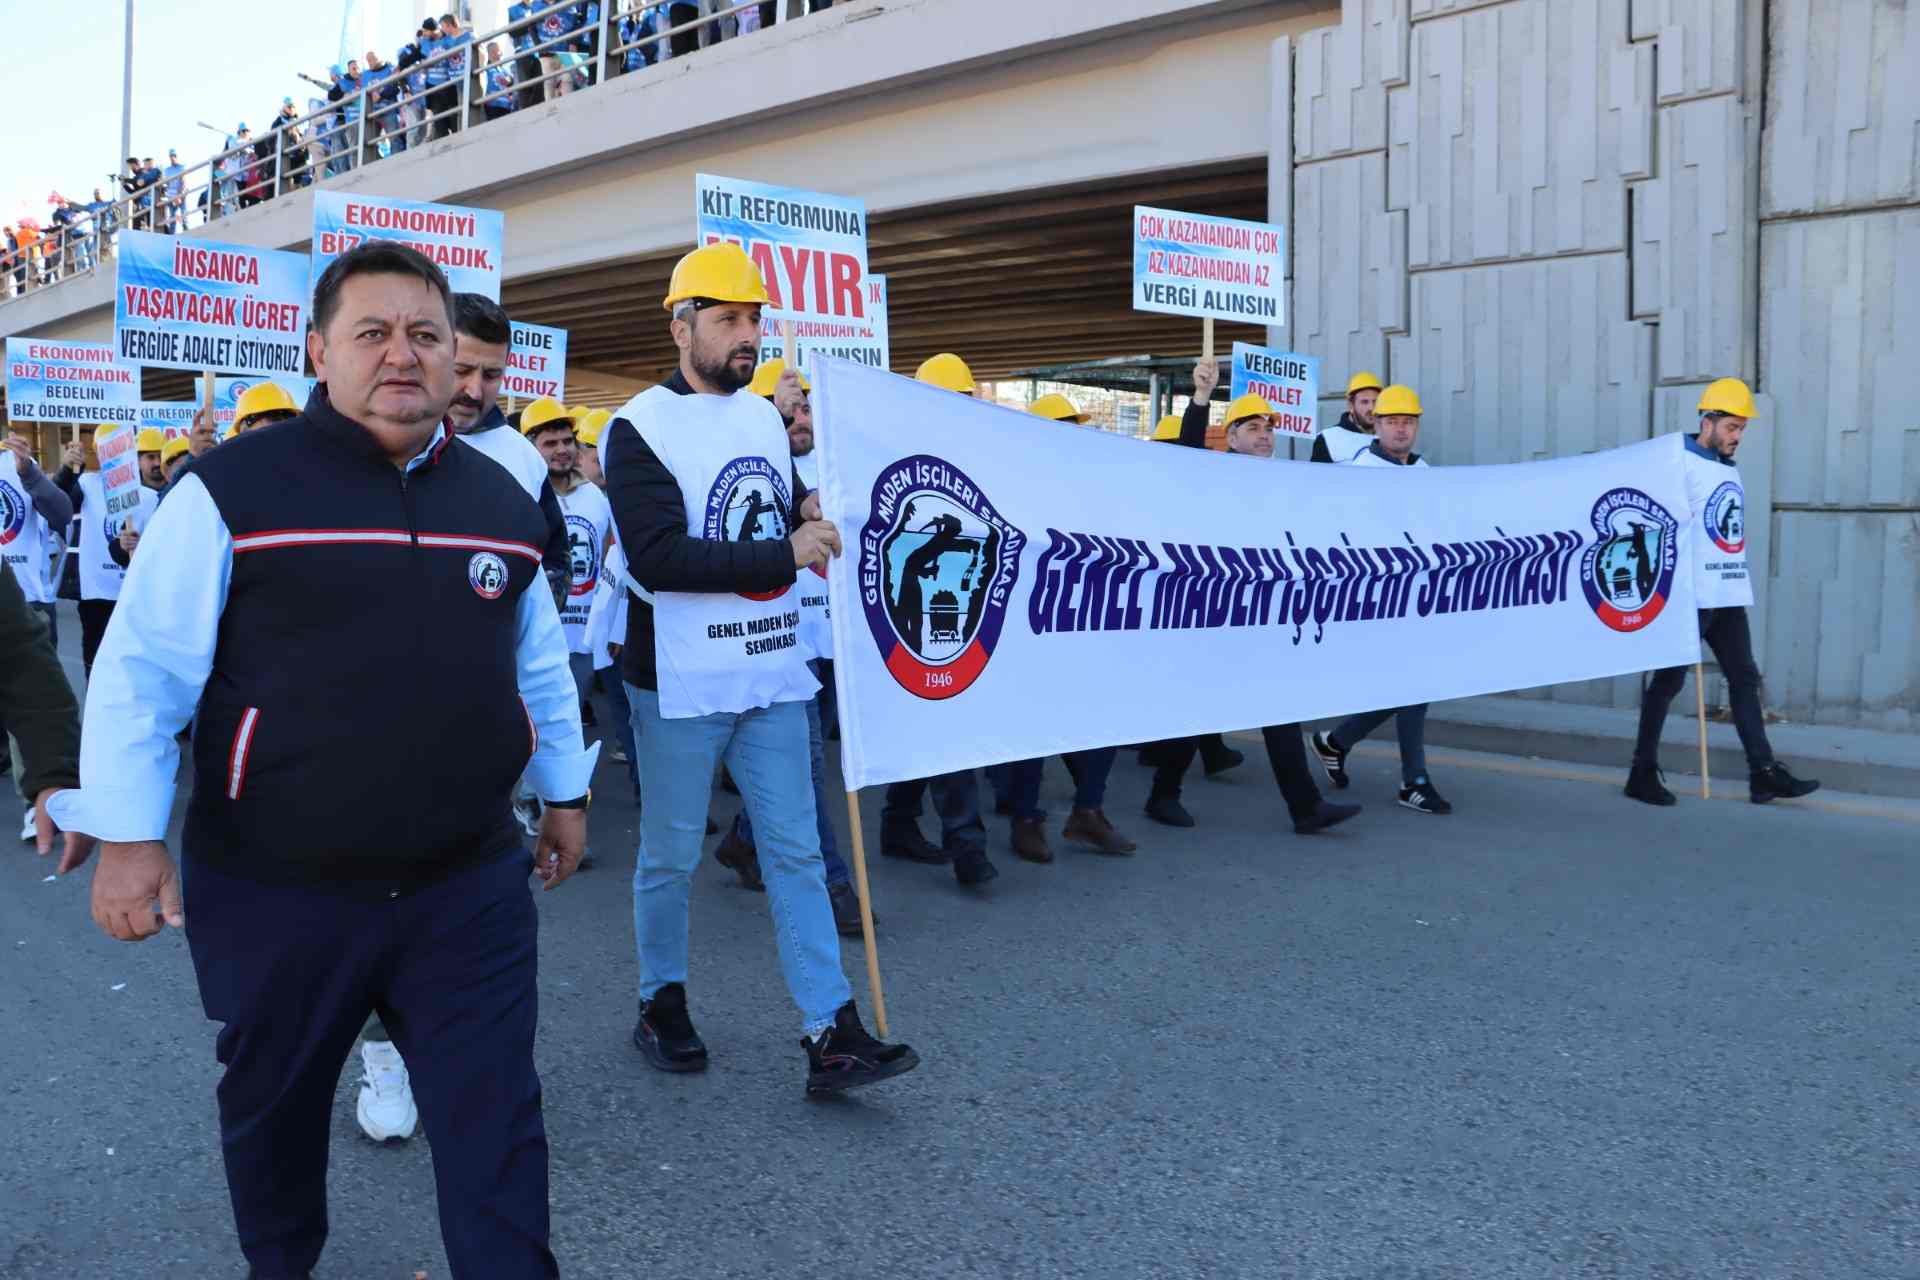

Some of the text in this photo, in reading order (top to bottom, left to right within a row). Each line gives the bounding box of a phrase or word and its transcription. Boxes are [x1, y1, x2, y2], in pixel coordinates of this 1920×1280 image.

[346, 204, 475, 238] EKONOMİYİ
[702, 186, 862, 236] KİT REFORMUNA
[1140, 214, 1279, 254] ÇOK KAZANANDAN ÇOK
[175, 242, 259, 286] İNSANCA
[385, 239, 494, 271] MADIK,
[1148, 252, 1269, 287] AZ KAZANANDAN AZ
[706, 235, 864, 319] AYIR
[126, 286, 300, 333] YAŞAYACAK ÜCRET
[1143, 282, 1277, 317] VERGİ ALINSIN
[121, 326, 300, 372] VERGİDE ADALET İSTİYORUZ
[513, 328, 553, 350] GİDE
[505, 352, 548, 372] ALET
[1245, 352, 1308, 381] VERGİDE
[503, 376, 558, 397] YORUZ
[864, 528, 885, 606] GENEL
[877, 467, 914, 524] MADEN
[916, 461, 980, 512] İŞÇİLERİ
[1028, 528, 1159, 635] GENEL
[1150, 542, 1293, 630] MADEN
[708, 622, 746, 639] GENEL
[747, 616, 782, 636] MADEN
[925, 671, 953, 688] 1946
